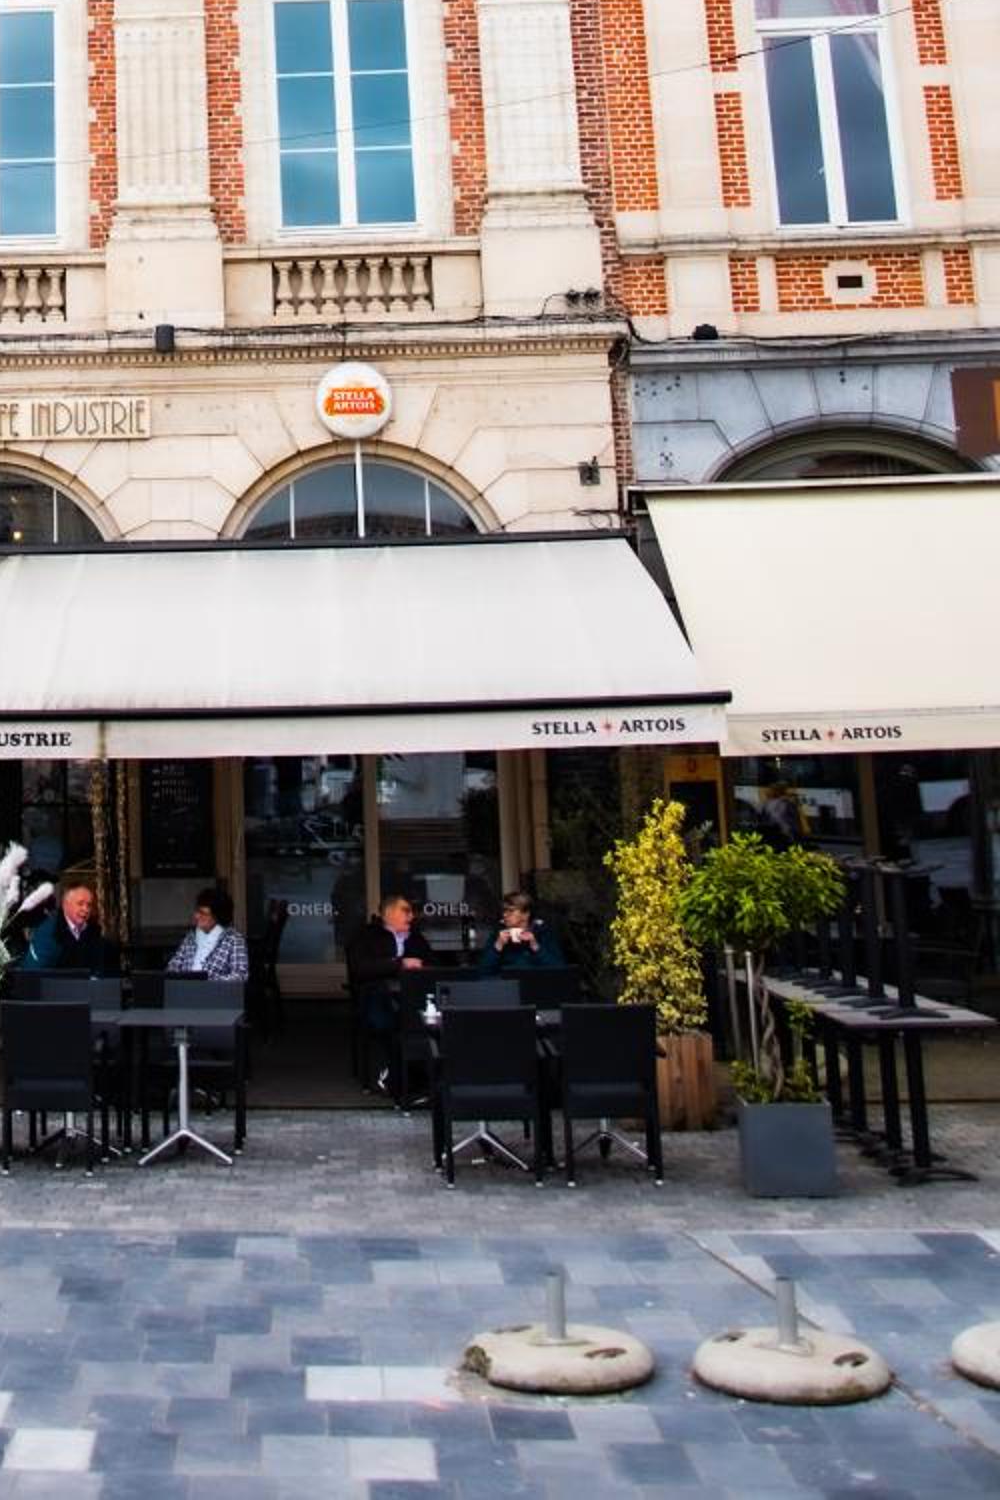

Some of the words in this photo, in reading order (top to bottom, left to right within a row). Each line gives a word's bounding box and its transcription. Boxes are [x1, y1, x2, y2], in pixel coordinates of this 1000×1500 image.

[31, 399, 147, 437] INDUSTRIE
[532, 721, 597, 735] STELLA
[619, 717, 685, 733] ARTOIS
[761, 727, 821, 743] STELLA
[841, 725, 902, 740] ARTOIS
